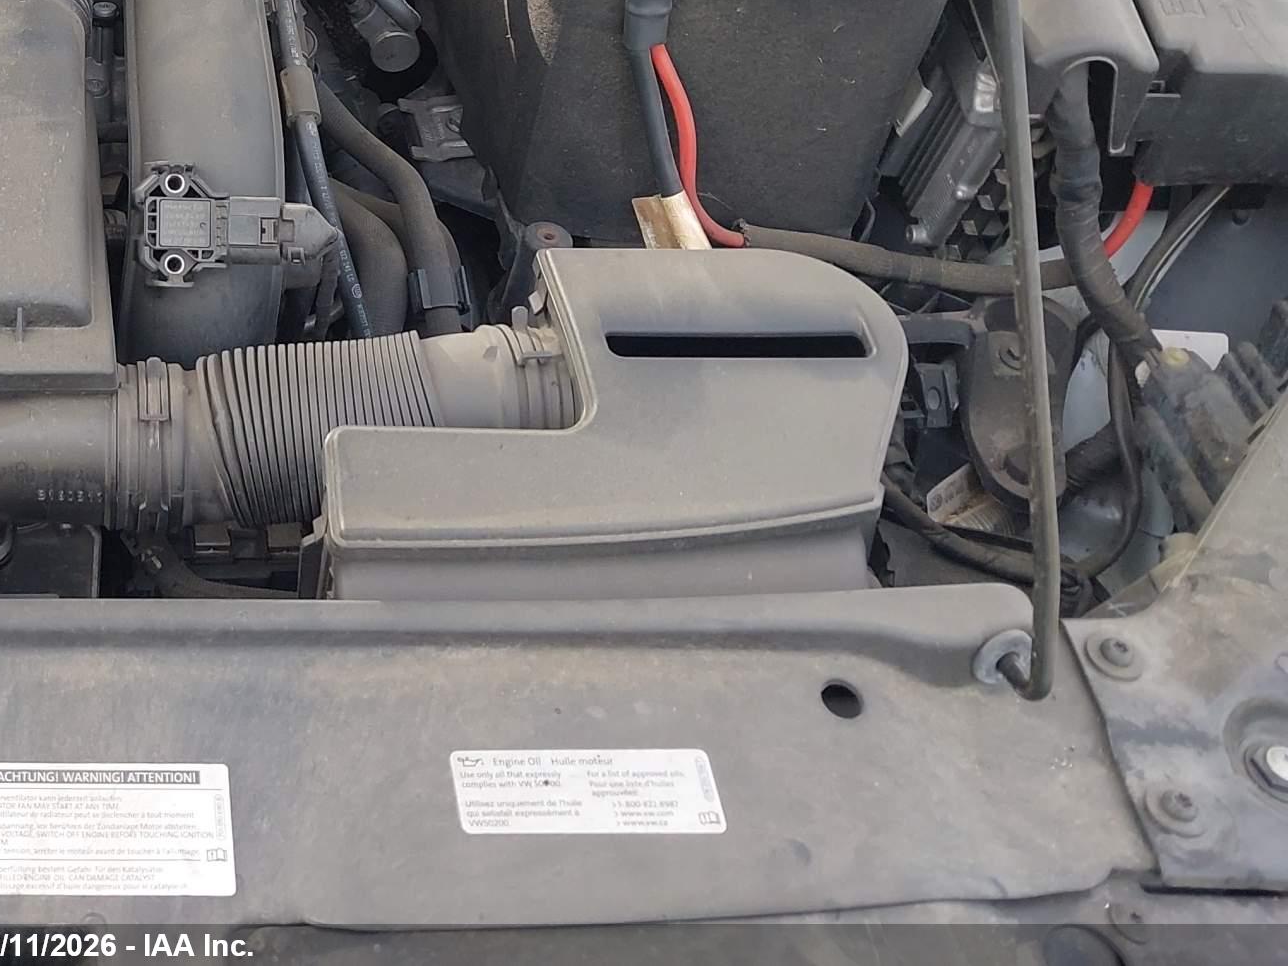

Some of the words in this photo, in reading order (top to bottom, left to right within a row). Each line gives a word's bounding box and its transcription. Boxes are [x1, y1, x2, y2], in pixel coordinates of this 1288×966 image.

[492, 757, 526, 768] Engine
[528, 757, 541, 766] Oil
[551, 757, 576, 766] Huile
[62, 770, 125, 784] WARNING!
[127, 770, 197, 784] ATTENTION!
[476, 772, 493, 780] only
[525, 772, 560, 780] expressly
[632, 770, 668, 779] approved
[462, 780, 496, 790] complies
[498, 780, 516, 788] with
[18, 802, 32, 810] FAN
[34, 802, 50, 810] MAY
[52, 802, 72, 810] START
[74, 802, 84, 810] AT
[85, 802, 100, 810] ANY
[466, 800, 494, 808] Utilisez
[546, 800, 556, 808] de
[466, 810, 479, 818] qui
